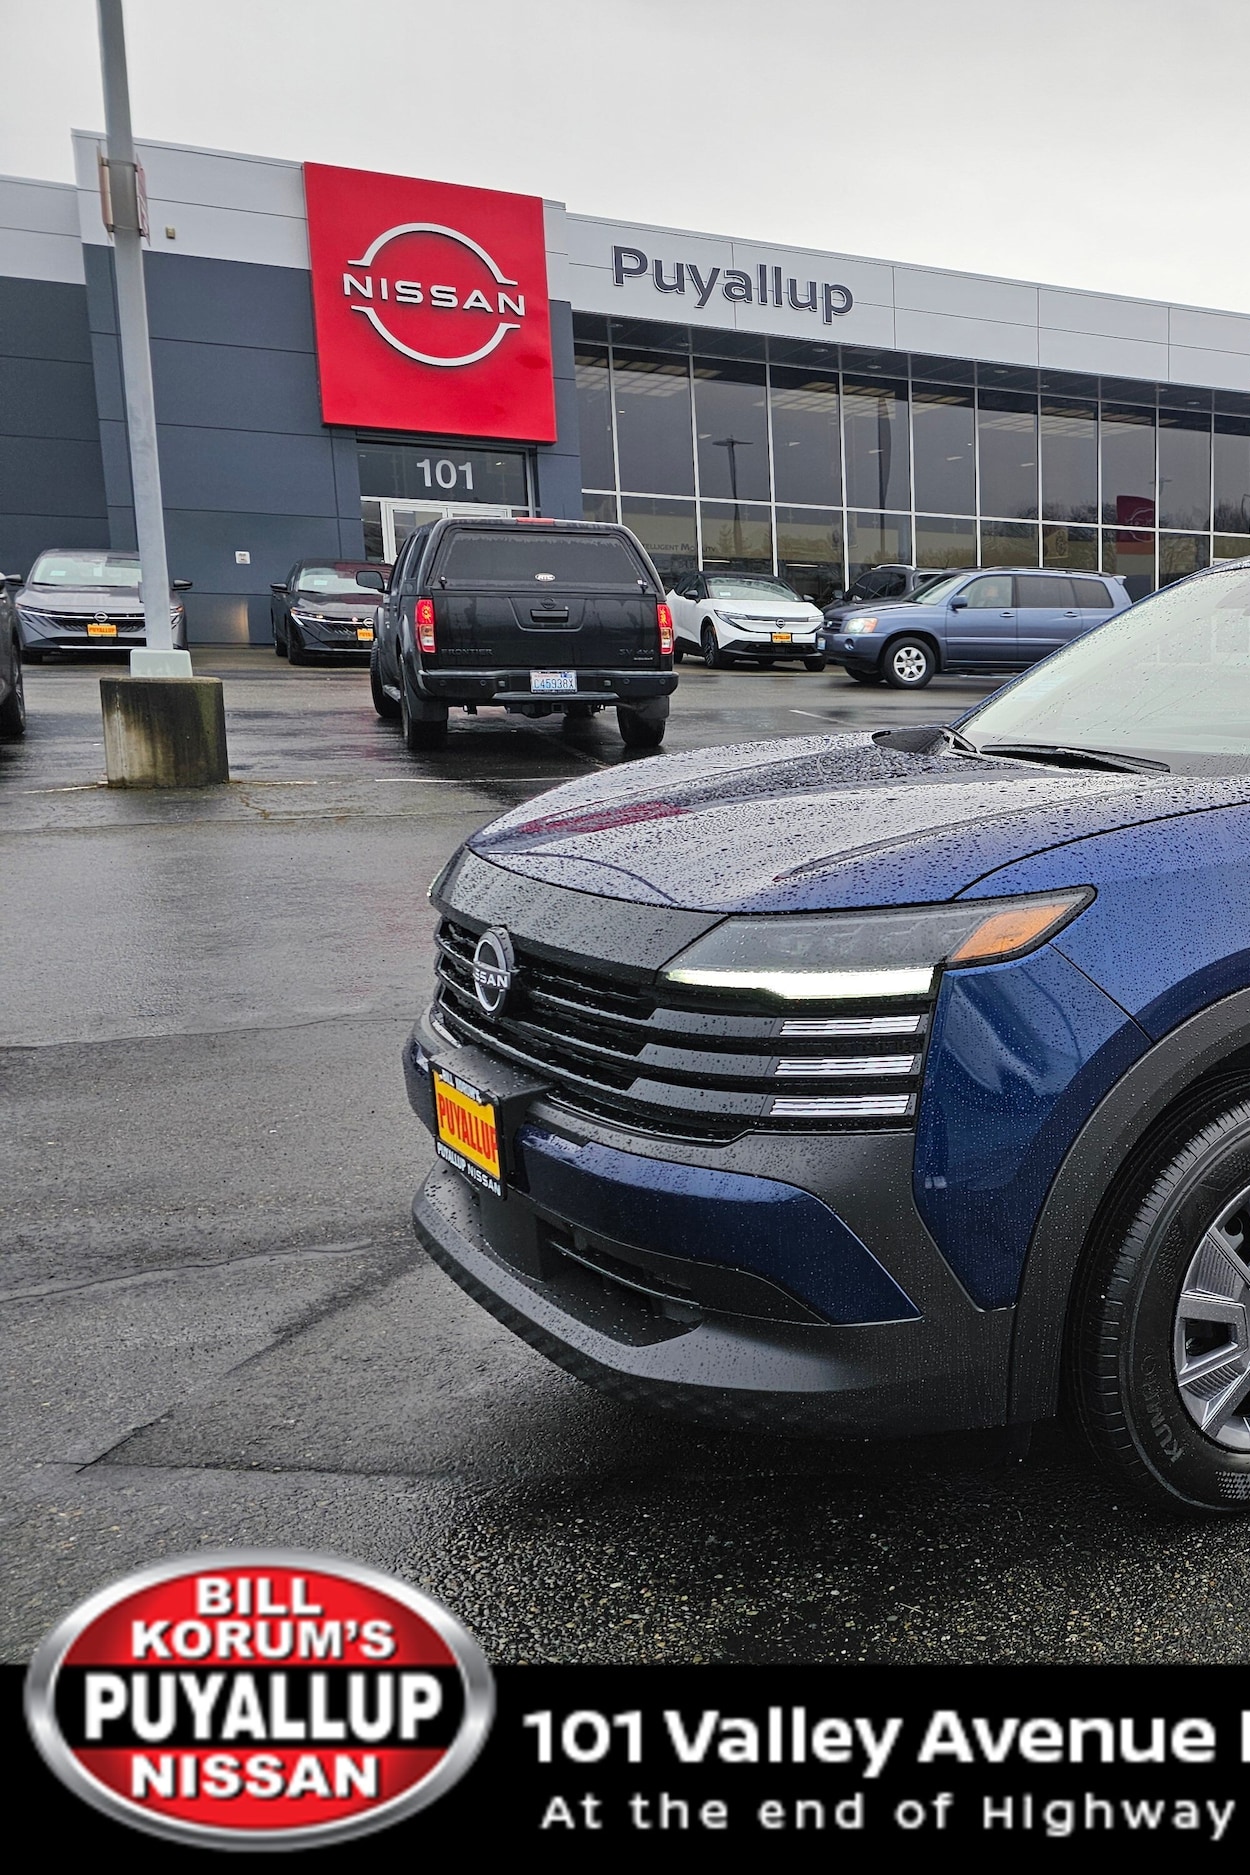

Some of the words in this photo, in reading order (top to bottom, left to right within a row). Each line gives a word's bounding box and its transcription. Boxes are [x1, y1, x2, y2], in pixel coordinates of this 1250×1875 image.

[343, 273, 526, 316] NISSAN
[612, 245, 854, 325] Puyallup
[416, 458, 474, 490] 101
[437, 1092, 498, 1164] PUYALLUP
[436, 1141, 467, 1173] PUYALLUP
[467, 1163, 502, 1197] NISSAN
